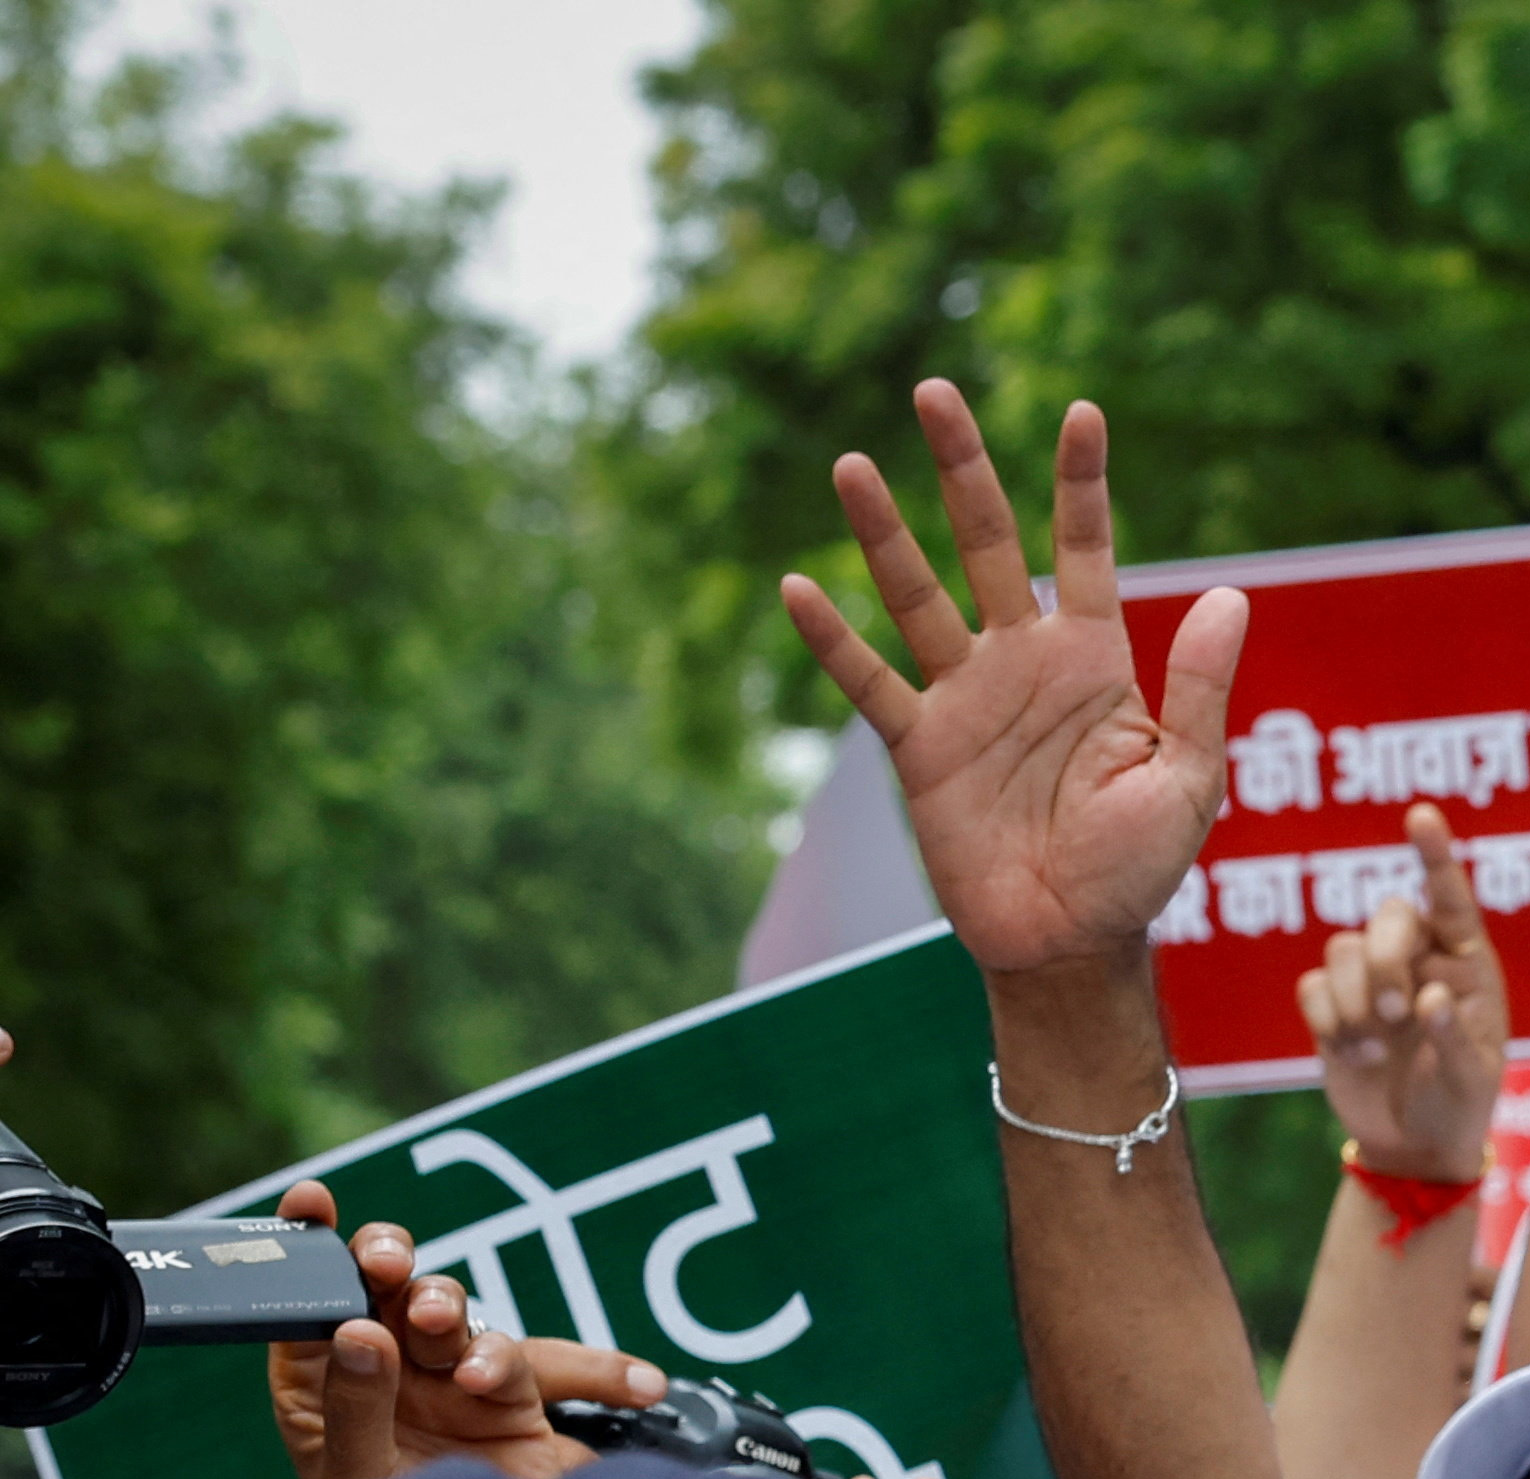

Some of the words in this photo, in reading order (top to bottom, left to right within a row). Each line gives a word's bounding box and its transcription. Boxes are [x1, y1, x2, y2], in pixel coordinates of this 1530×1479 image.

[1229, 709, 1323, 814] की
[1330, 712, 1530, 808] आवाज़
[1215, 856, 1306, 936] का
[127, 1248, 192, 1270] 4K
[734, 1435, 802, 1474] Canon
